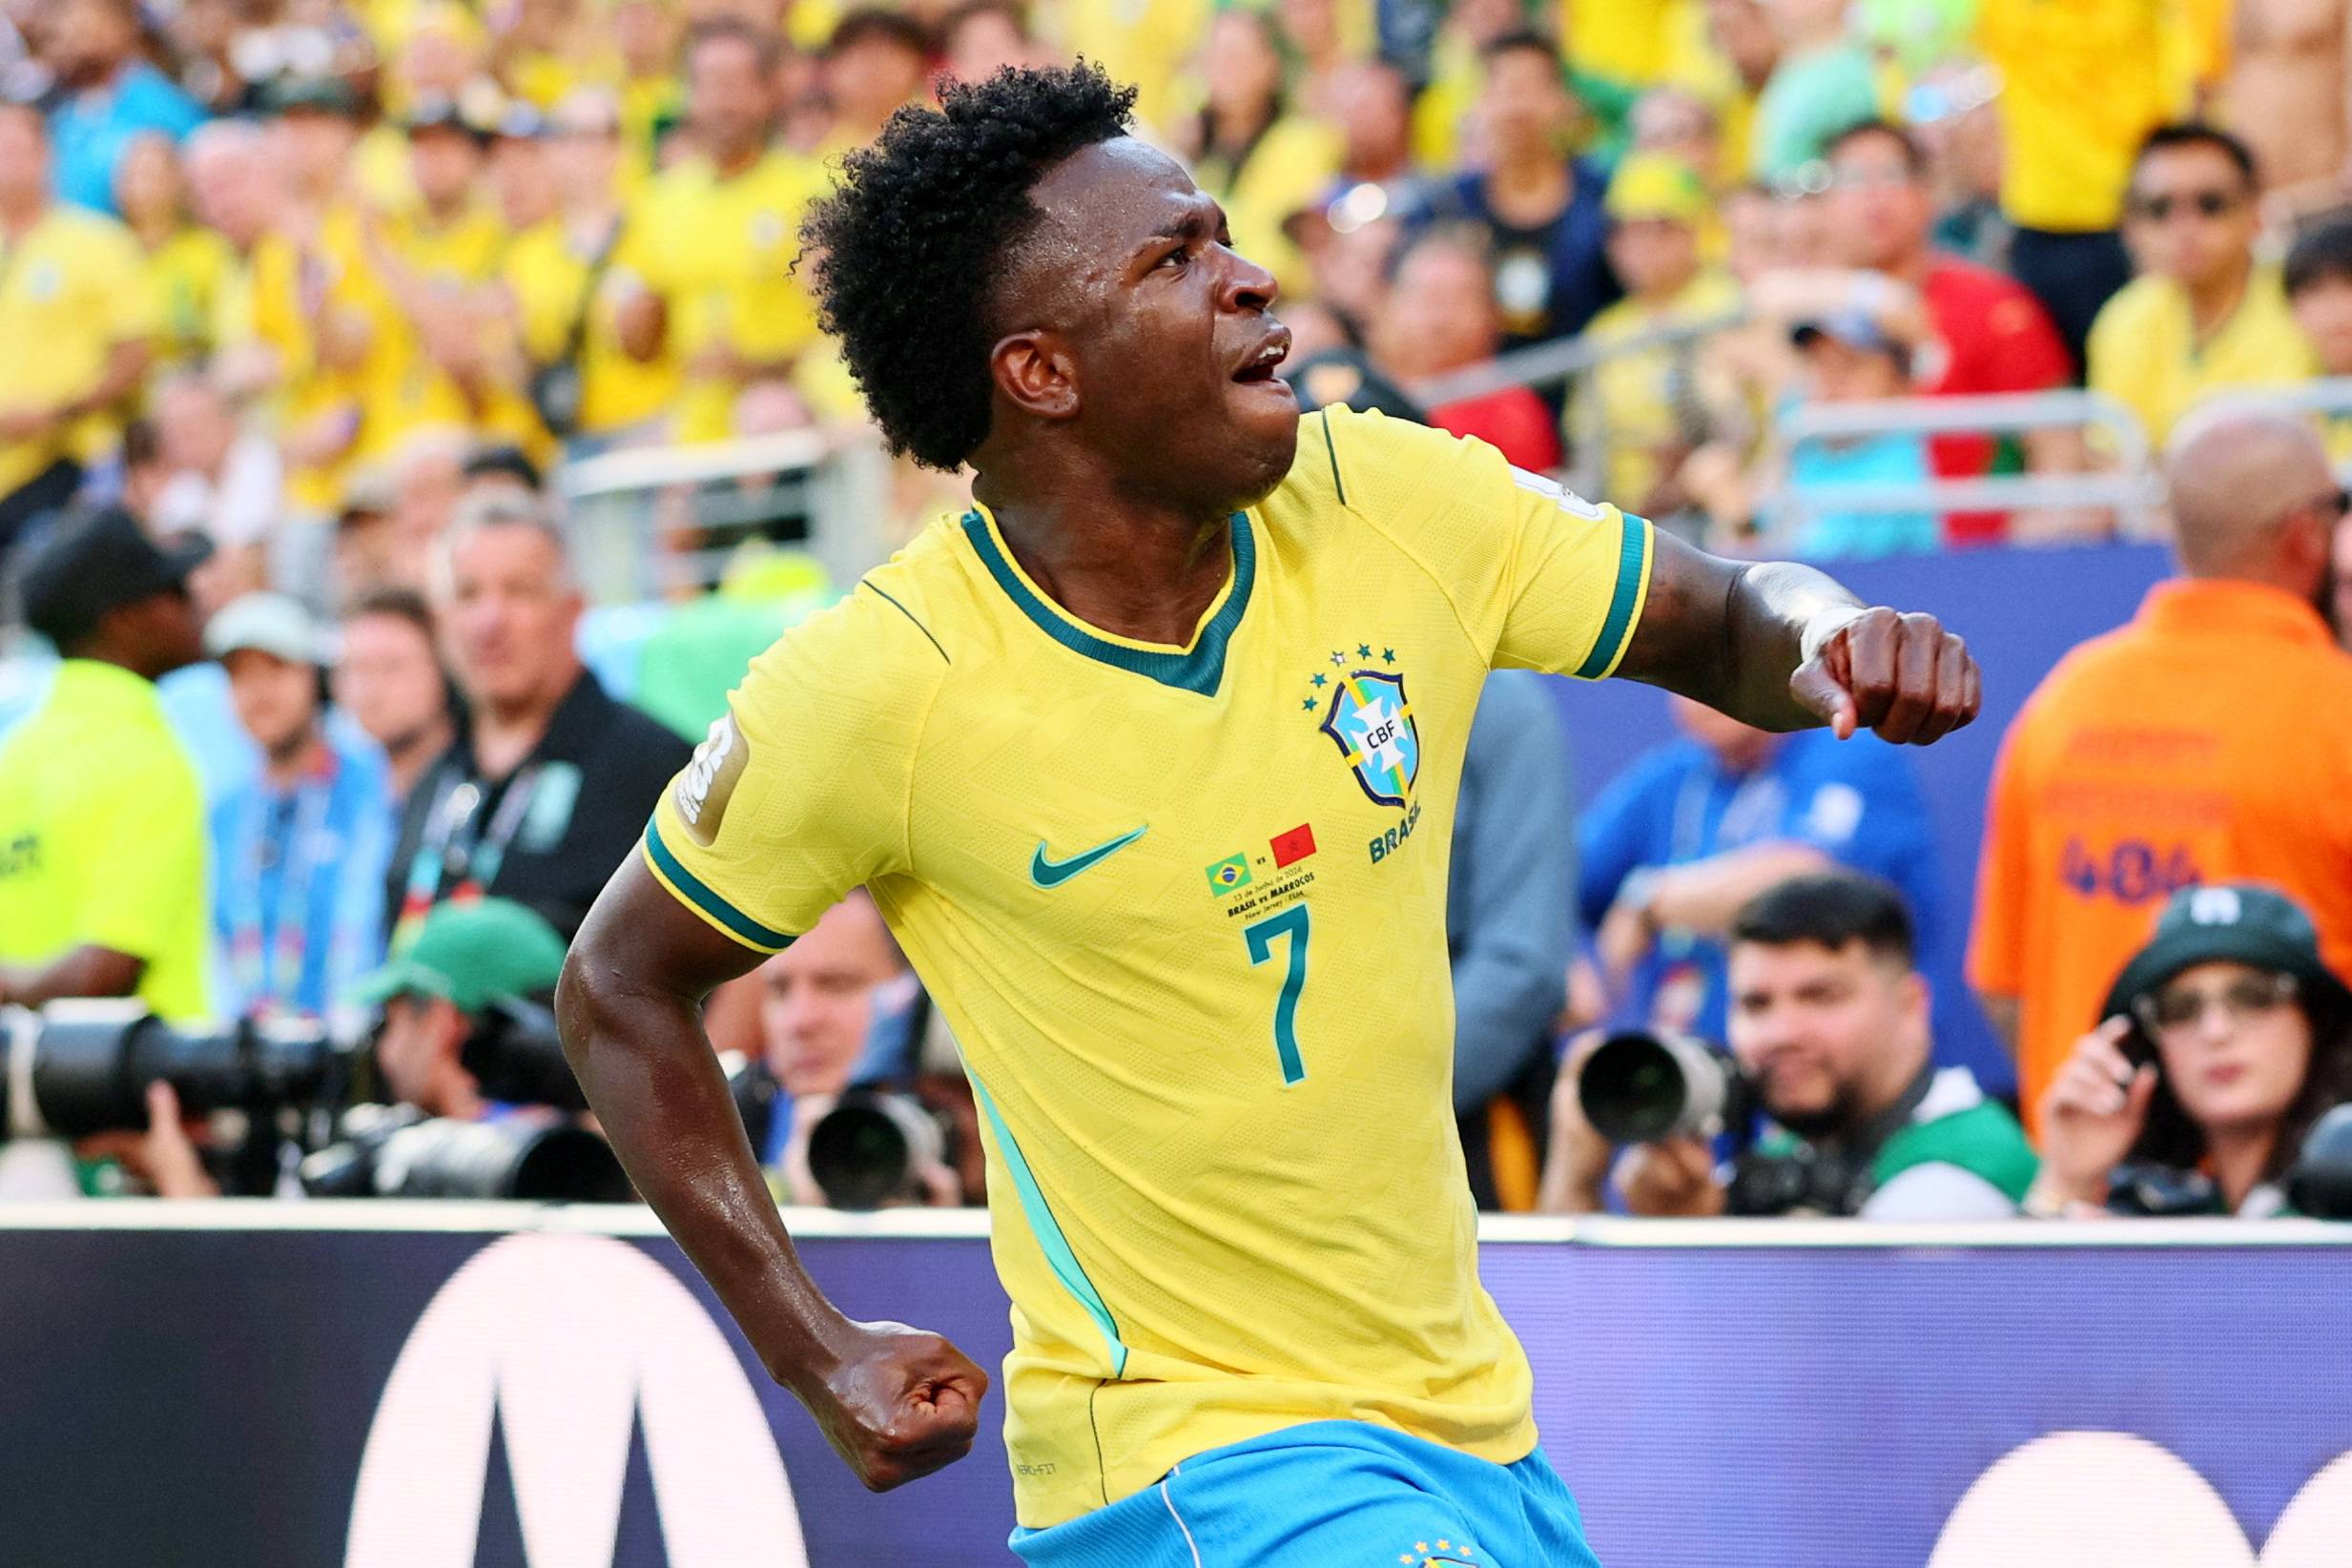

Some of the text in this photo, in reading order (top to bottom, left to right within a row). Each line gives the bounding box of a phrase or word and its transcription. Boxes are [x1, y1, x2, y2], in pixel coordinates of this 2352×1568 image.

[1366, 719, 1396, 750] CBF
[1228, 872, 1315, 918] BRASIL vs MARROCOS
[1245, 911, 1261, 920] New
[1264, 900, 1283, 913] Jersey
[1244, 902, 1310, 1085] 7
